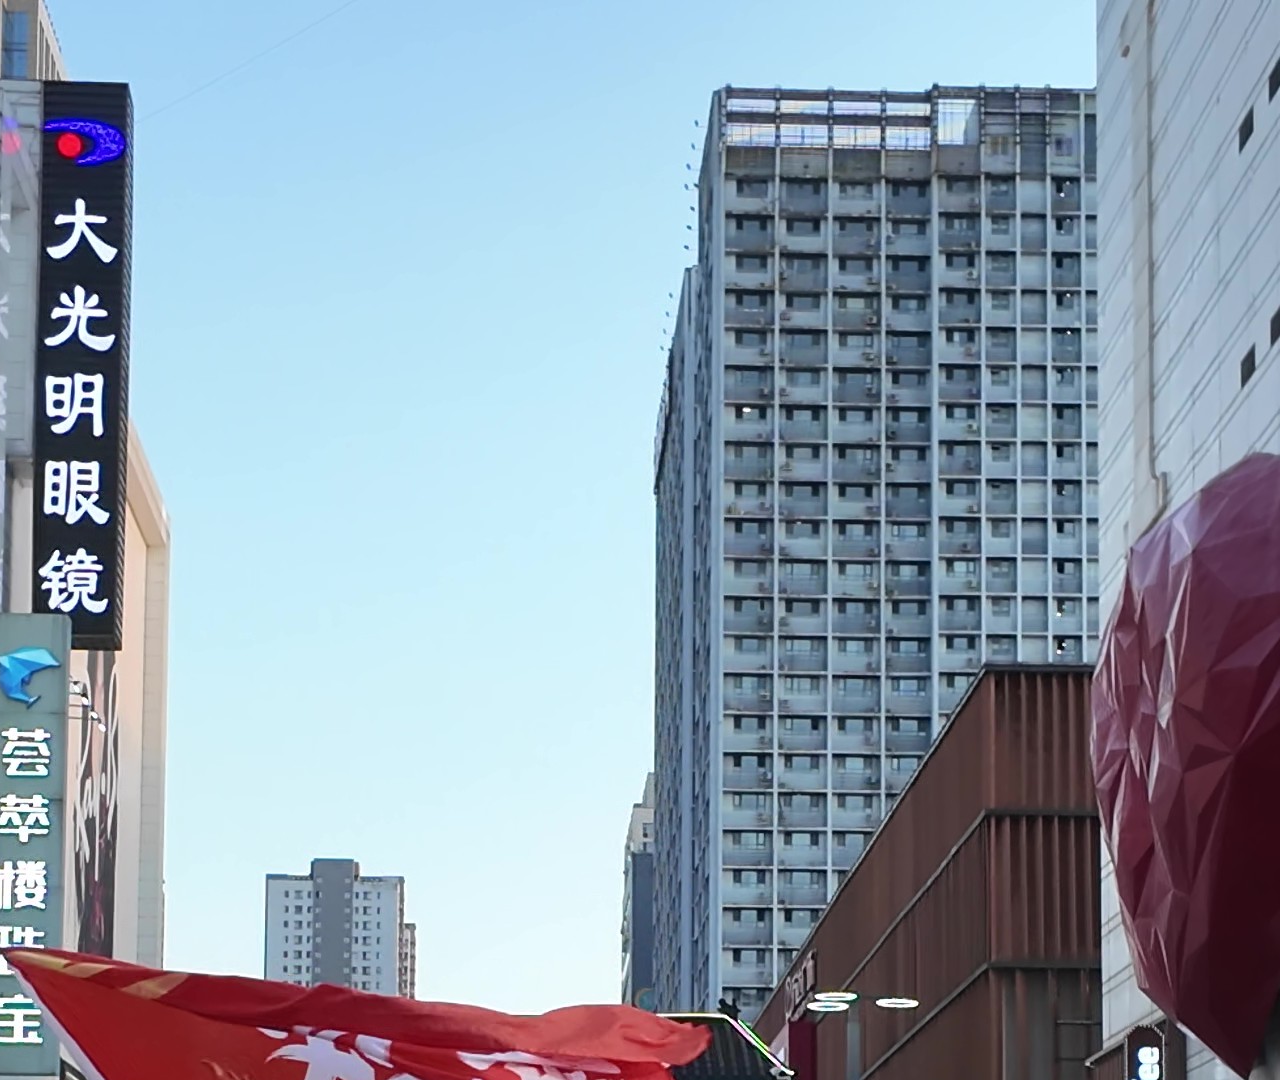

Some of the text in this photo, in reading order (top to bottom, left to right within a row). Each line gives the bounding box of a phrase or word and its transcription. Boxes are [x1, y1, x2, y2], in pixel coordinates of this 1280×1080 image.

[38, 198, 118, 614] 大光明眼镜
